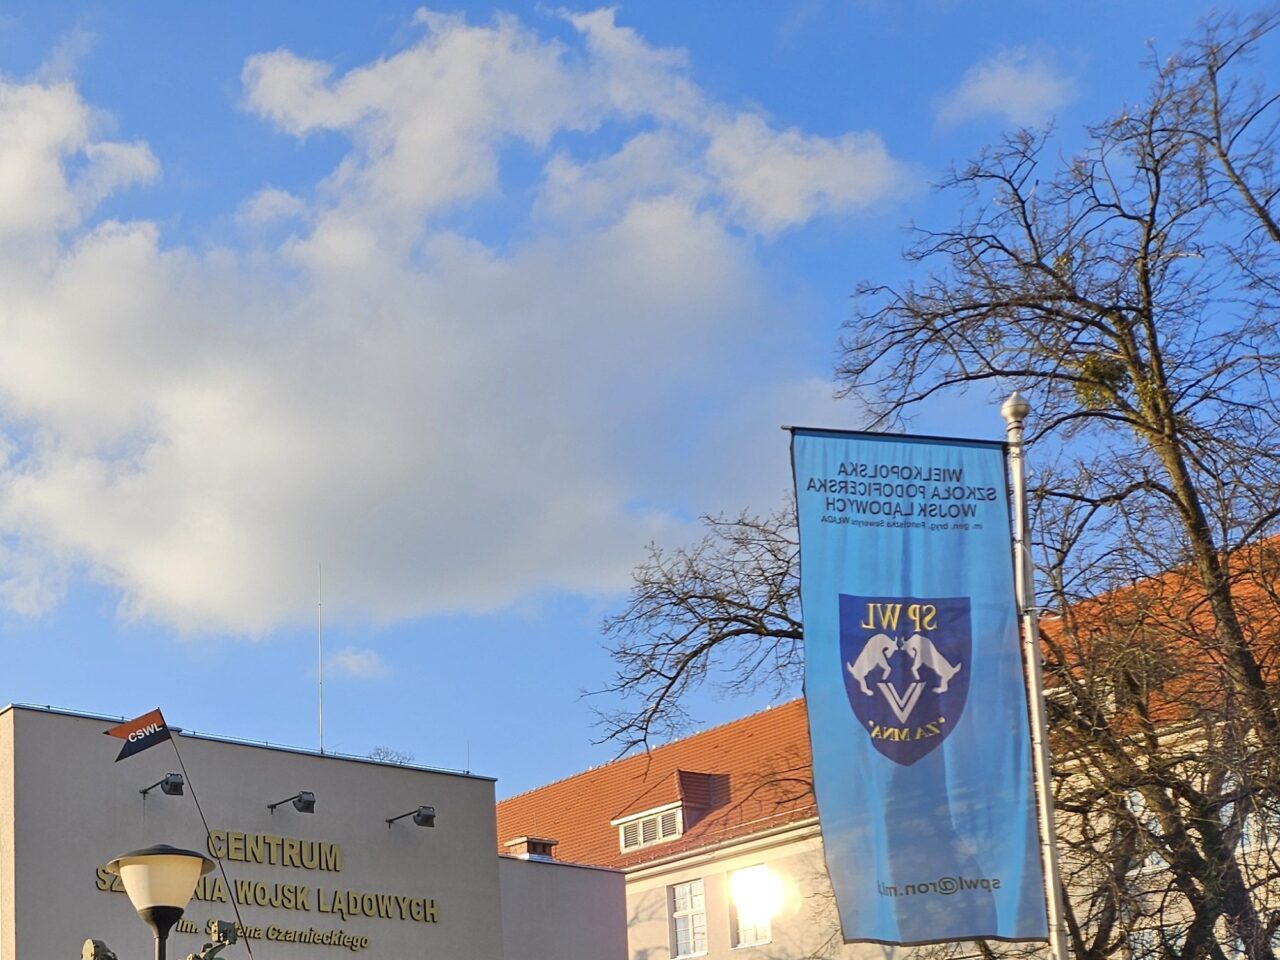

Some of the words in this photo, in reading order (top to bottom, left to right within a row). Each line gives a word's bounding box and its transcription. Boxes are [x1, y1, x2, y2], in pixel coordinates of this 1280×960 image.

[128, 722, 163, 743] CSWL
[207, 829, 343, 873] CENTRUM
[95, 862, 227, 904] SZNIA
[234, 878, 311, 911] WOJSK
[317, 886, 441, 923] LĄDOWYCH
[266, 924, 371, 951] Czarnieckiego
